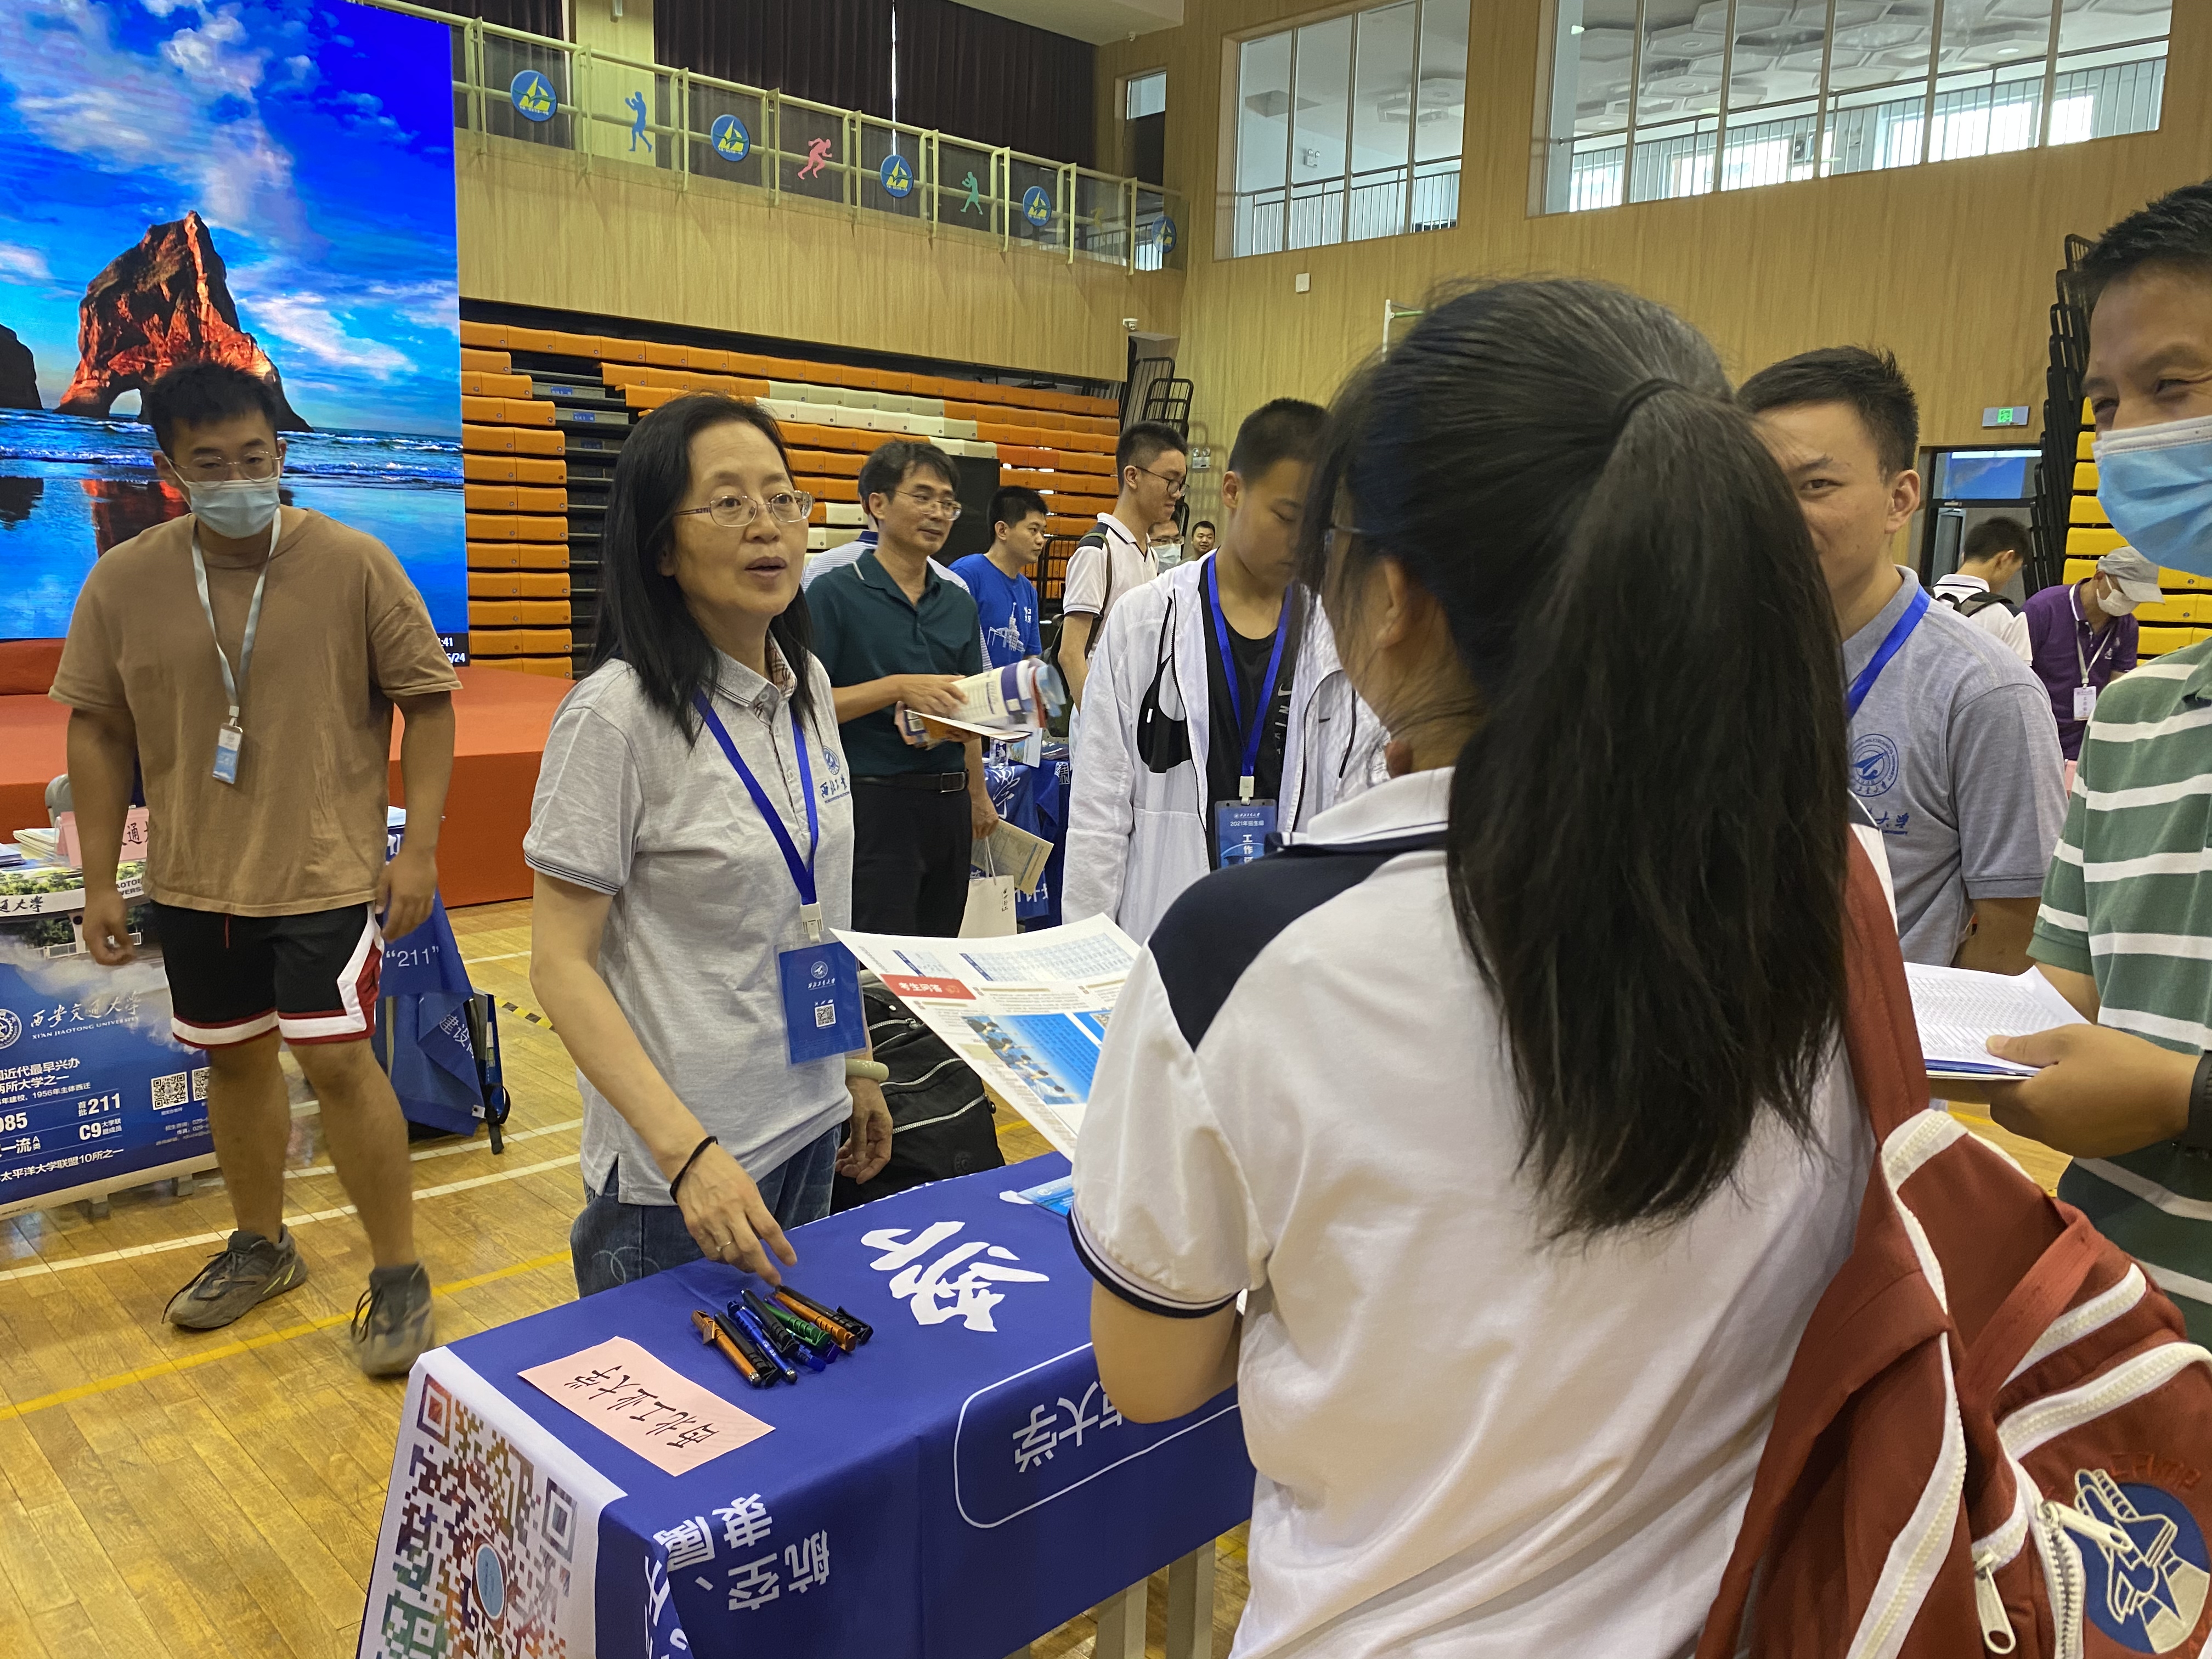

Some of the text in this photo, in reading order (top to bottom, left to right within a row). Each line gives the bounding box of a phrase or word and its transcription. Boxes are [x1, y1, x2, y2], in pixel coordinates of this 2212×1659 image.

[438, 637, 453, 647] :41
[386, 945, 439, 969] “211”
[898, 982, 943, 993] 考生问答
[55, 1024, 94, 1036] JIAOTONG
[88, 1093, 120, 1115] 211
[79, 1122, 101, 1141] C9
[0, 1137, 32, 1158] 一流
[0, 1149, 125, 1182] 太平洋大学联盟10所之一
[652, 1492, 773, 1573] 隶属
